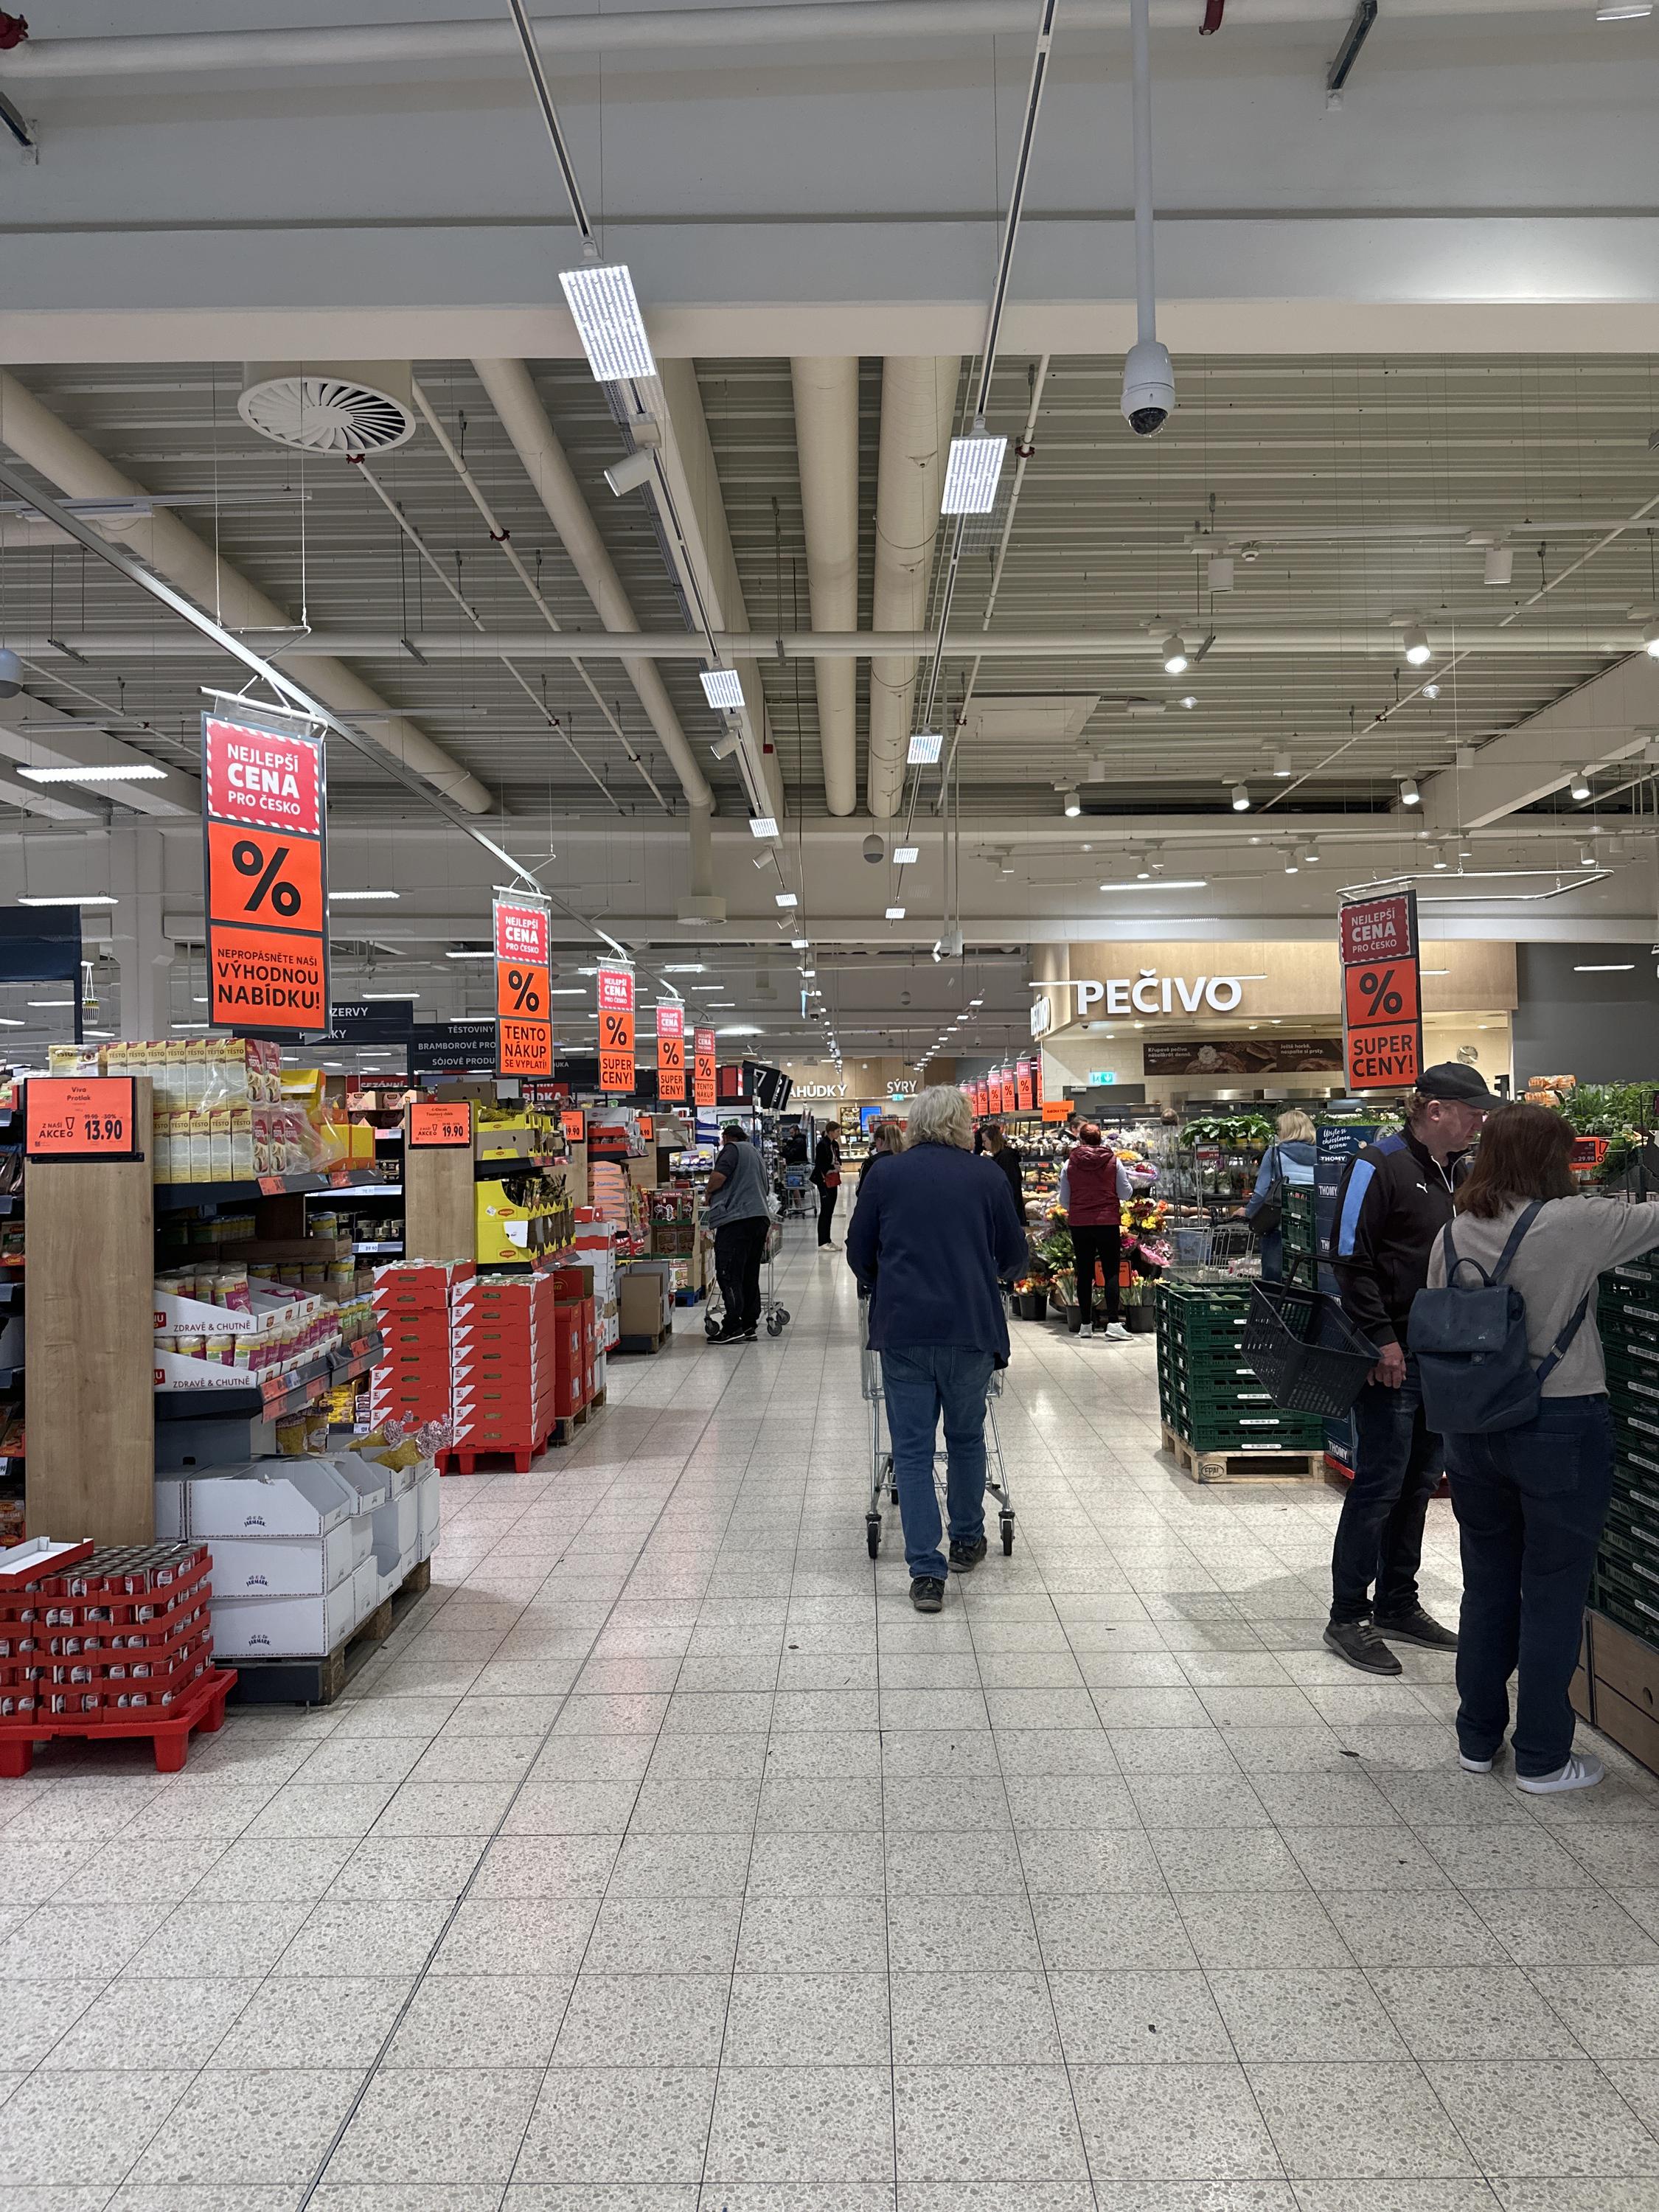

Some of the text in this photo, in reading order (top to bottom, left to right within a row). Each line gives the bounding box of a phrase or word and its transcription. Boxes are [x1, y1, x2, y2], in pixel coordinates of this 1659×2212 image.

[227, 742, 299, 773] NEJLEPŠÍ
[227, 762, 300, 799] CENA
[228, 790, 301, 815] PRO ČESKO
[505, 916, 538, 930] NEJLEPŠÍ
[1352, 907, 1396, 927] NEJLEPŠÍ
[505, 926, 539, 945] CENA
[1352, 922, 1397, 943] CENA
[506, 942, 540, 954] PRO ČESKO
[1352, 939, 1397, 953] PRO ČESKO
[218, 947, 294, 964] NEPROPÁSNĚTE
[218, 960, 319, 986] VÝHODNOU
[218, 983, 320, 1010] NABÍDKU!
[604, 985, 627, 997] CENA
[1077, 968, 1242, 1015] PEČIVO
[331, 1007, 369, 1017] ZERVY
[661, 1018, 679, 1027] CENA
[448, 1026, 495, 1034] TĚSTOVINY
[504, 1026, 546, 1042] TENTO
[418, 1040, 477, 1050] BRAMBOROVÉ
[504, 1041, 546, 1059] NÁKUP
[1354, 1034, 1413, 1056] SUPER
[432, 1057, 464, 1065] SÓJOVÉ
[505, 1059, 547, 1070] SE VYPLATÍ!
[602, 1057, 633, 1071] SUPER
[1353, 1054, 1413, 1077] CENY!
[602, 1071, 633, 1085] CENY!
[661, 1075, 683, 1084] SUPER
[660, 1085, 684, 1095] CENY!
[789, 1081, 848, 1098] AHŮDKY
[887, 1078, 917, 1093] SÝRY
[522, 1091, 562, 1102] BÍDKA
[84, 1120, 122, 1140] 13.90
[442, 1125, 464, 1137] 19.90
[1318, 1185, 1338, 1197] THOMY
[174, 1321, 206, 1332] ZDRAVĚ
[217, 1320, 251, 1329] CHUTNĚ
[173, 1377, 205, 1388] ZDRAVĚ
[216, 1376, 250, 1385] CHUTNĚ
[1328, 1439, 1348, 1461] THOMY
